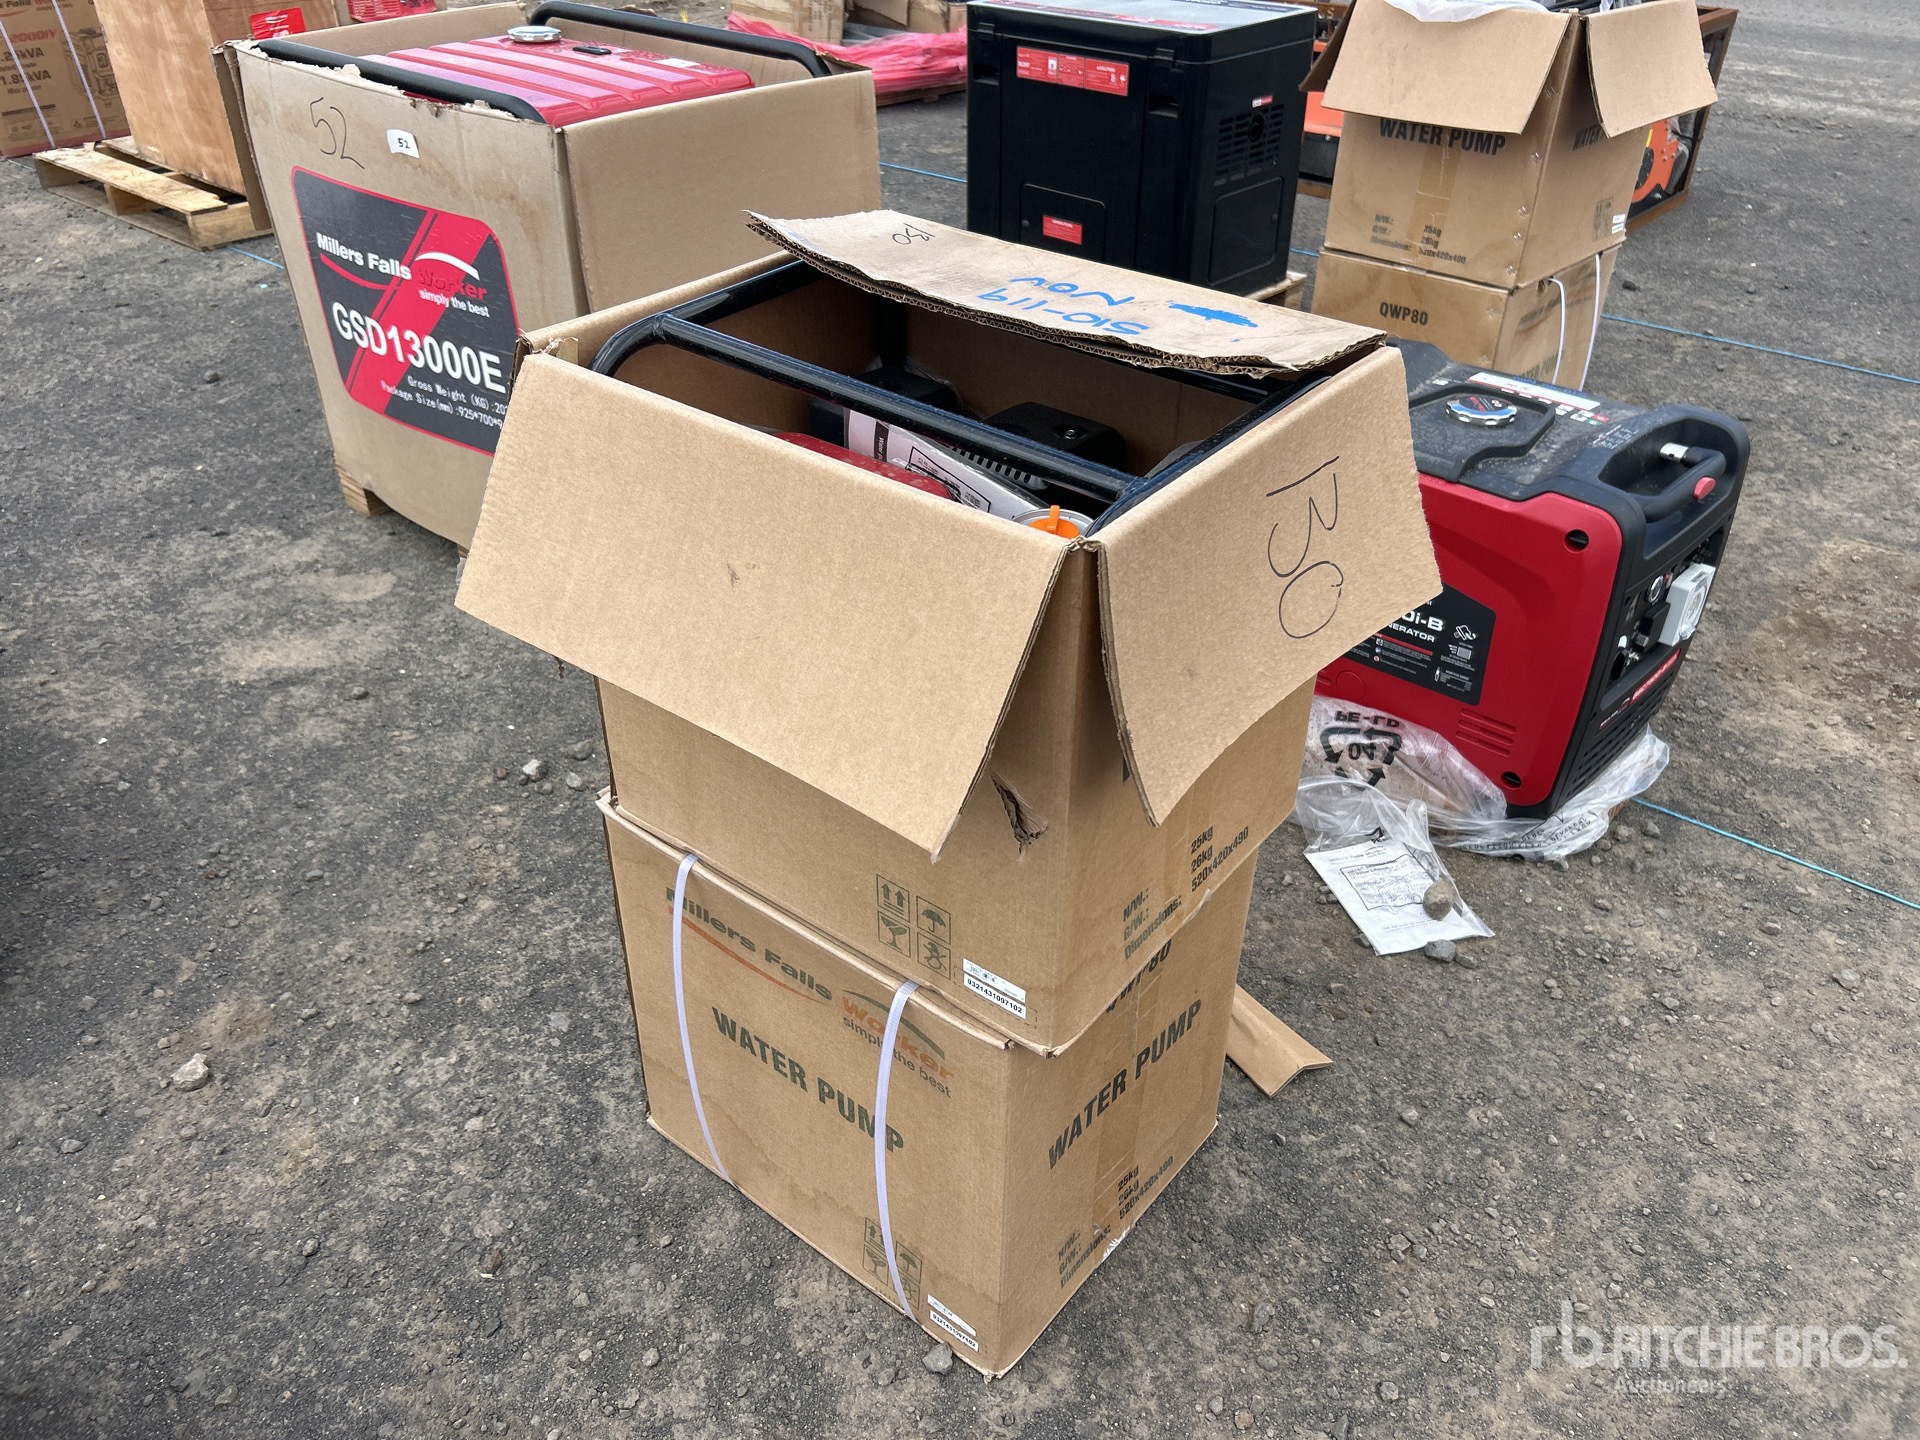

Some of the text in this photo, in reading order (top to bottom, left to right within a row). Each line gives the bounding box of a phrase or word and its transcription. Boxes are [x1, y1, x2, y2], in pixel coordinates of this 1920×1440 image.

[0, 70, 52, 85] 1.8kVA
[310, 97, 365, 169] 52
[398, 138, 411, 149] 52
[1379, 118, 1506, 155] WATER PUMP
[316, 232, 413, 281] Millers Falls
[418, 267, 488, 299] Worker
[419, 289, 490, 318] simply the best
[1379, 302, 1428, 326] QWP80
[332, 302, 506, 393] GSD13000E
[380, 380, 414, 402] Package
[407, 375, 433, 393] Gross
[434, 382, 467, 403] Weight
[1123, 825, 1213, 922] N/W.: 25kg
[1191, 845, 1213, 875] 26kg
[1125, 895, 1182, 961] Dimensions:
[1191, 826, 1249, 892] 520x420x490
[765, 948, 833, 1001] Falls
[967, 978, 1023, 1014] 9321431097102
[712, 1006, 808, 1093] WATER
[842, 996, 955, 1080] Woker
[843, 1016, 883, 1048] simpl
[919, 1066, 952, 1099] best
[1048, 998, 1202, 1170] WATER PUMP
[1118, 1165, 1139, 1192] 25kg
